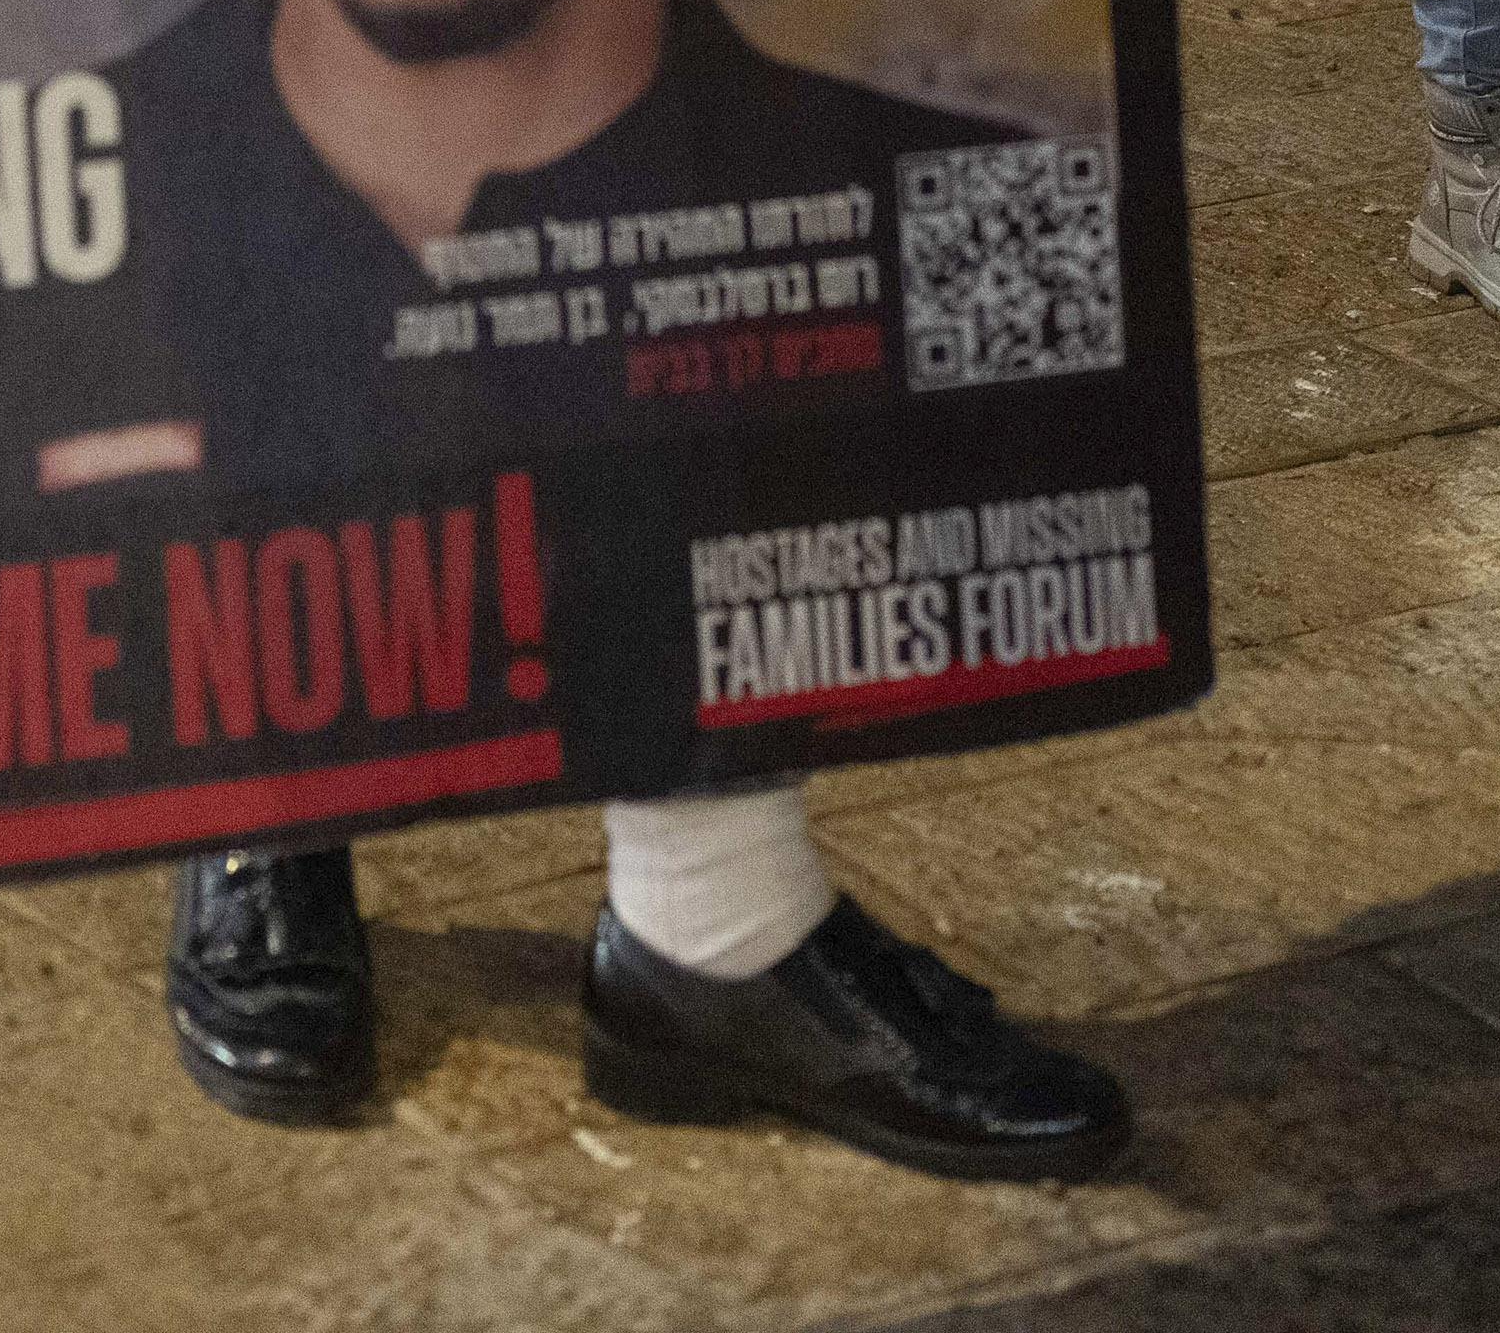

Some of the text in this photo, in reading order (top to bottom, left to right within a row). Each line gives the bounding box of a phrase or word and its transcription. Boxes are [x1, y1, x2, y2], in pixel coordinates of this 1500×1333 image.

[164, 472, 549, 747] NOW!
[692, 483, 1152, 609] HOSTAGES AND MISSING
[700, 551, 1158, 704] FAMILIES FORUM
